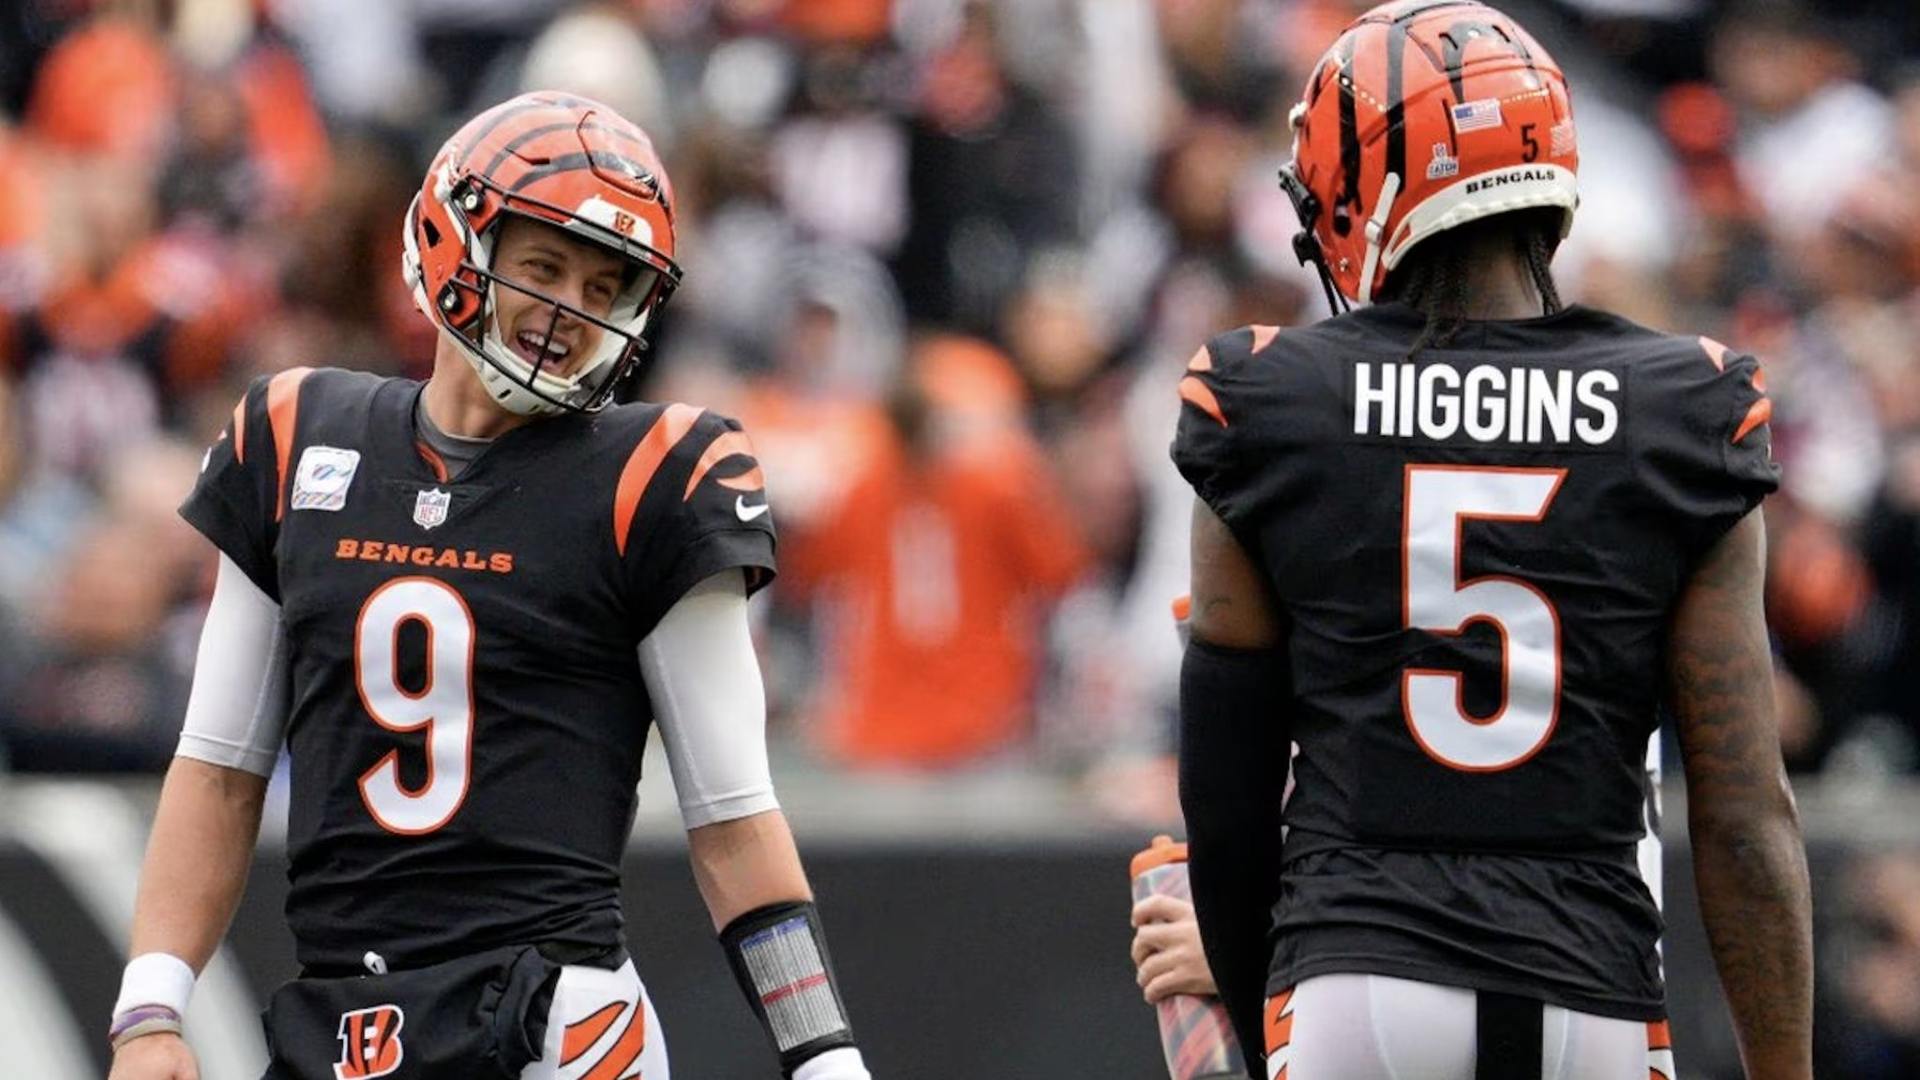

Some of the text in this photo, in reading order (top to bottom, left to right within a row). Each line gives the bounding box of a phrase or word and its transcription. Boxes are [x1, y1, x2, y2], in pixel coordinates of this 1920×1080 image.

[1521, 123, 1538, 163] 5
[1465, 170, 1555, 194] BENGALS
[1354, 362, 1620, 445] HIGGINS
[335, 538, 514, 574] BENGALS
[1400, 463, 1569, 773] 5
[354, 575, 475, 836] 9
